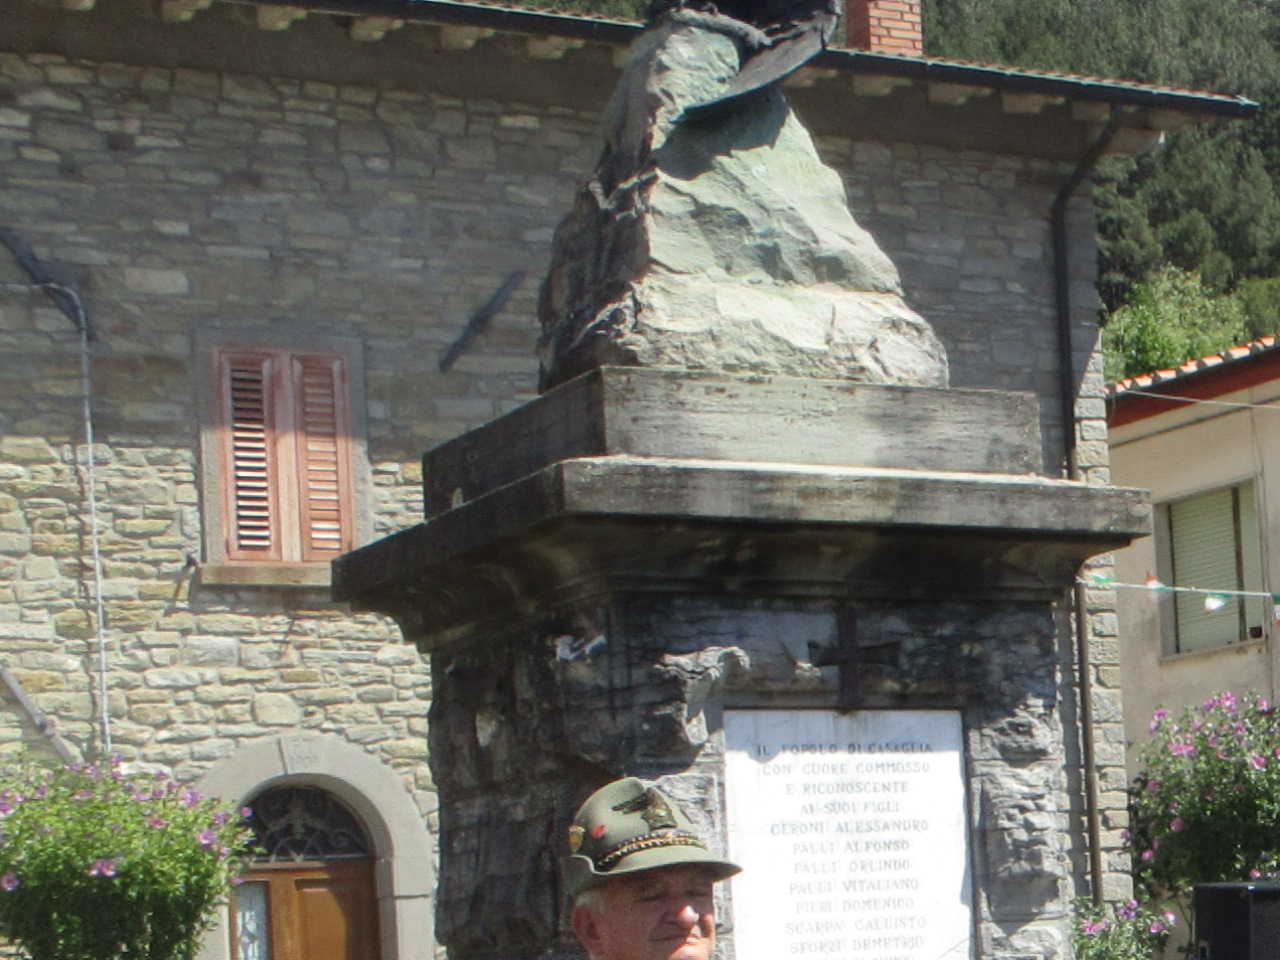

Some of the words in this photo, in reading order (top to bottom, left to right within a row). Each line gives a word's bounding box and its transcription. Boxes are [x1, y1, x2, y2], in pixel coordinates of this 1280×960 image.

[757, 744, 771, 757] IL
[847, 743, 862, 754] DI
[867, 742, 934, 753] CASAGLIA
[762, 763, 792, 776] CON
[801, 762, 848, 776] CUORE
[856, 761, 931, 775] COMMOSSO
[786, 783, 795, 795] E
[801, 781, 909, 795] RICONOSCENTE
[823, 801, 857, 815] SUOI
[863, 800, 900, 814] FIGLI
[769, 821, 825, 836] CERONI
[834, 819, 930, 834] ALESSANDRO
[844, 839, 911, 854] ALFONSO
[842, 877, 920, 893] VITALIANO
[842, 897, 915, 912] DOMENICO
[853, 915, 928, 931] CALLISTO
[851, 935, 925, 951] DEMETRIO
